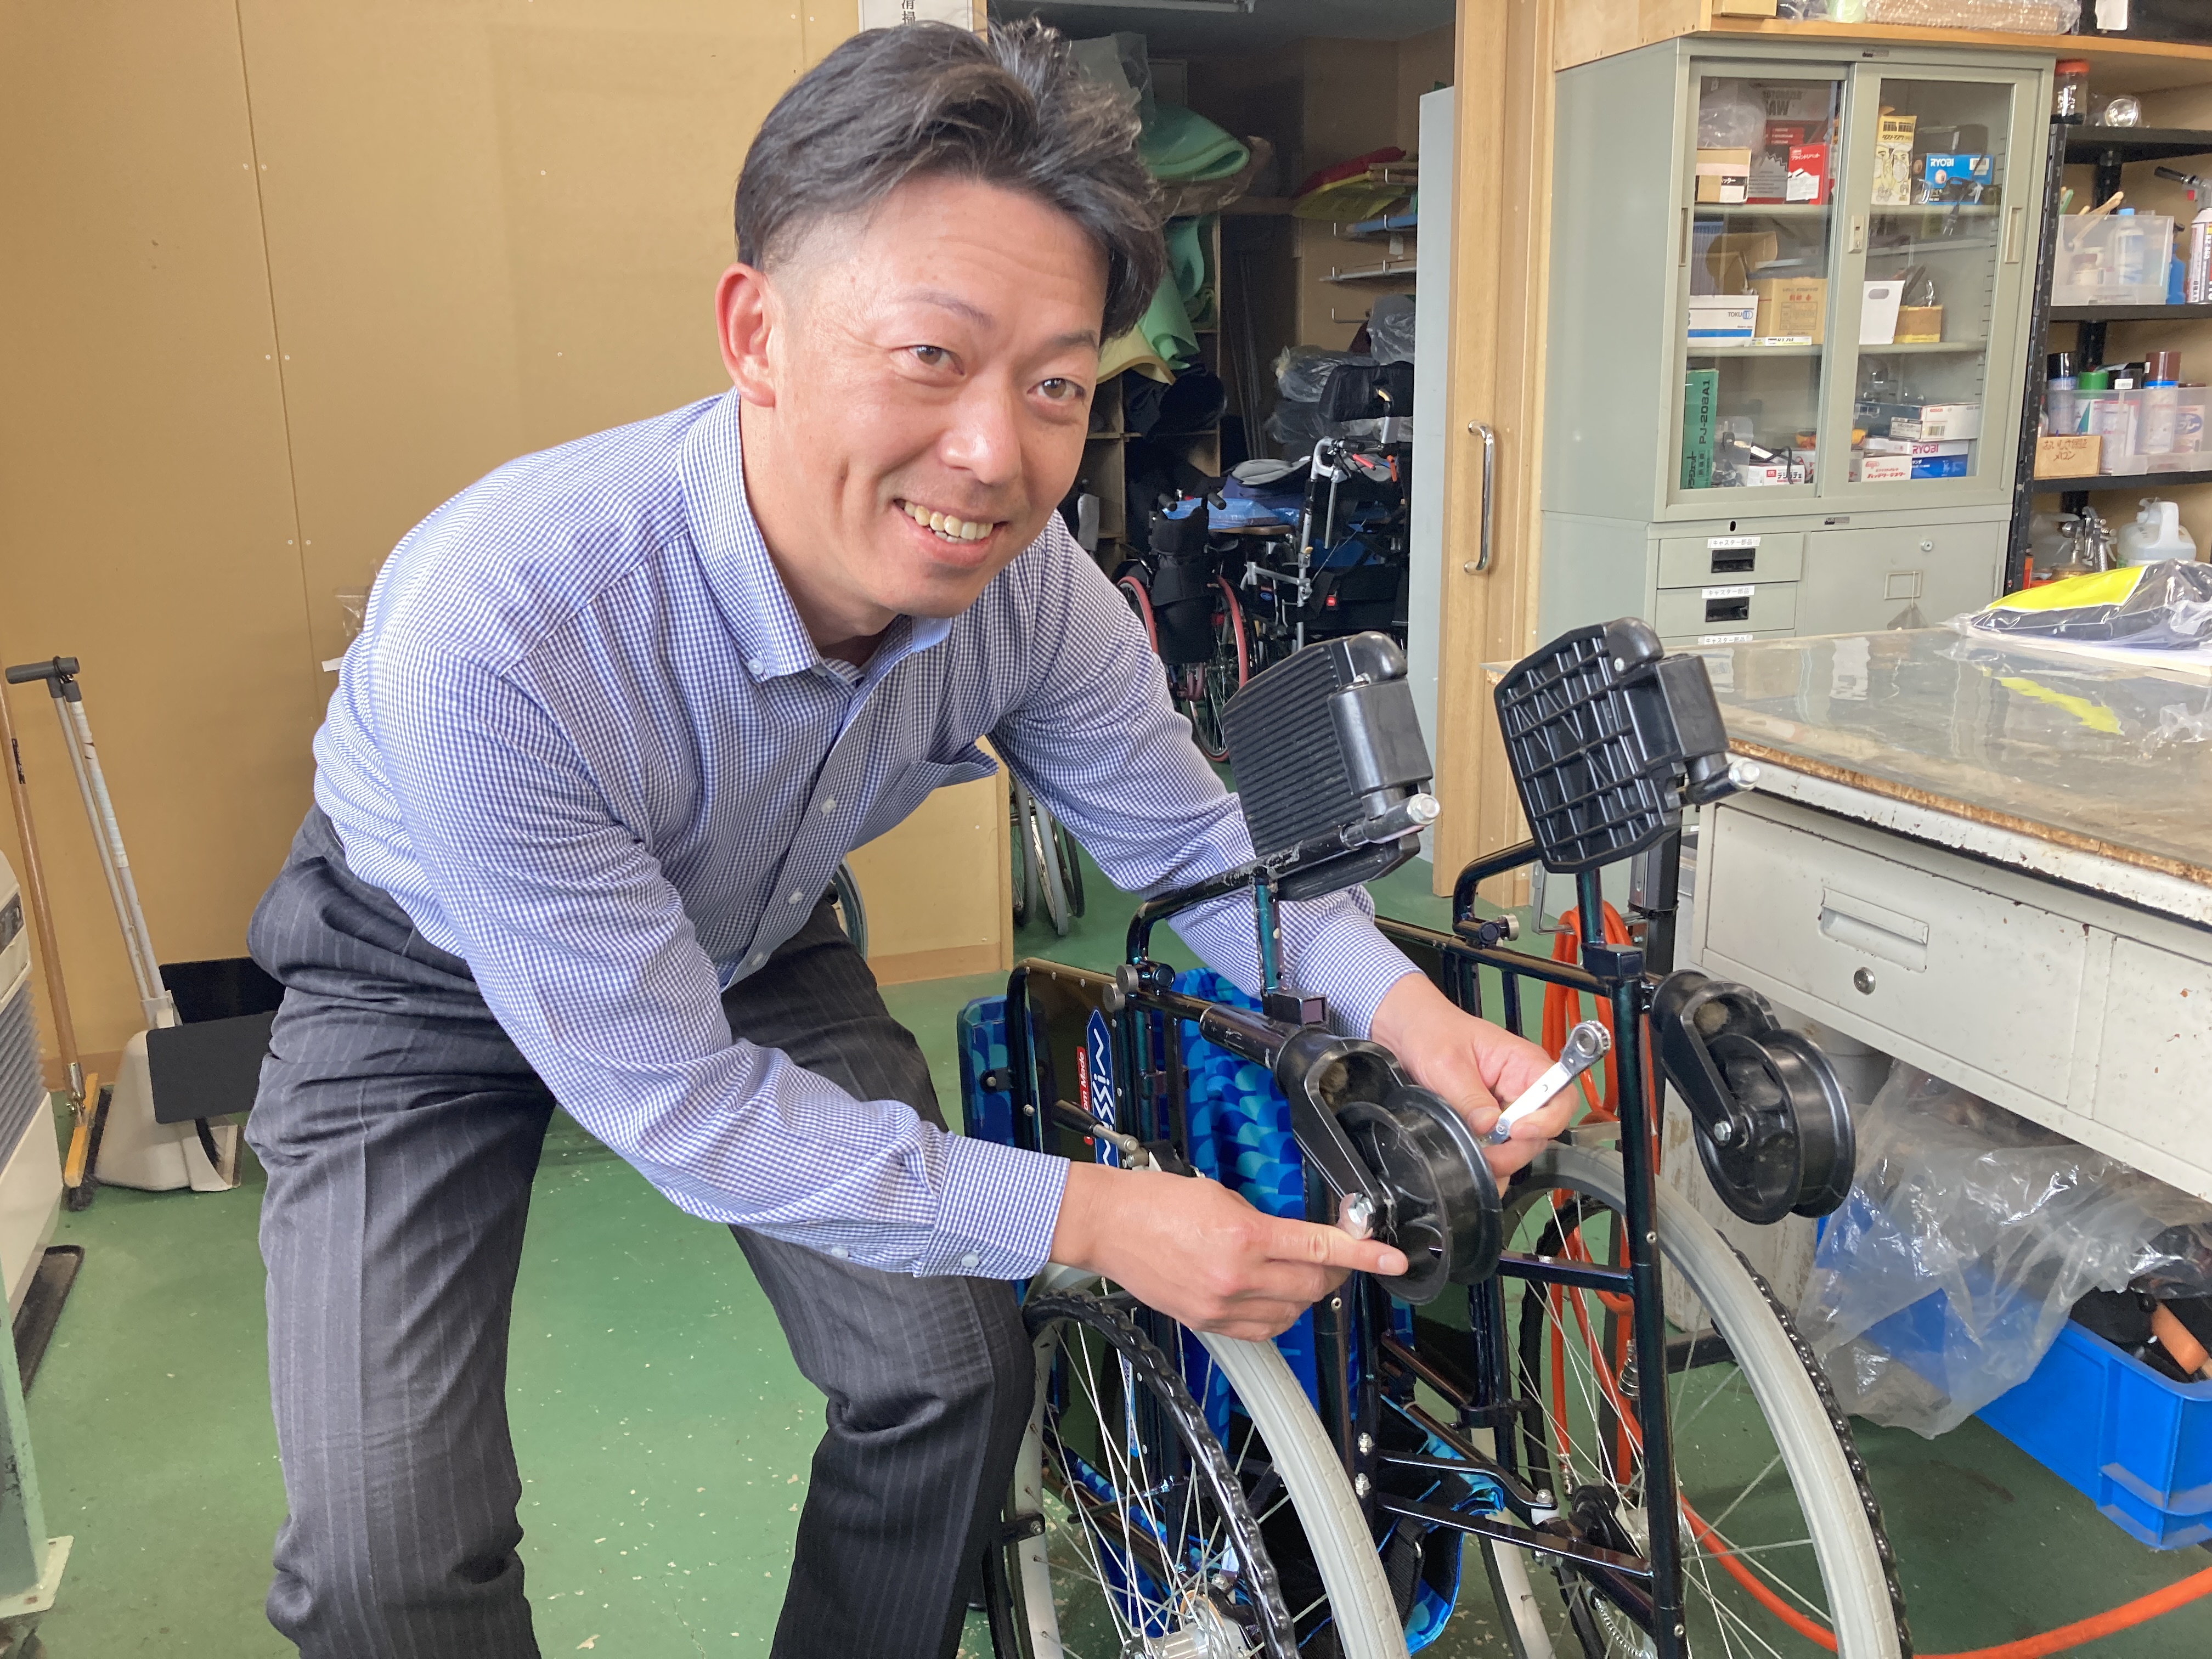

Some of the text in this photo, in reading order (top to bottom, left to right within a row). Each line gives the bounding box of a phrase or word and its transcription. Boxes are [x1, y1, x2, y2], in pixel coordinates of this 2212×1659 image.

[1930, 157, 1955, 167] RYOBI
[1699, 380, 1711, 445] PJ-208A1
[1912, 444, 1939, 454] RYOBI
[2053, 451, 2075, 461] メロン
[1712, 538, 1753, 546] キャスター部品
[1708, 588, 1750, 596] キャスター部品
[1078, 1051, 1087, 1087] Made
